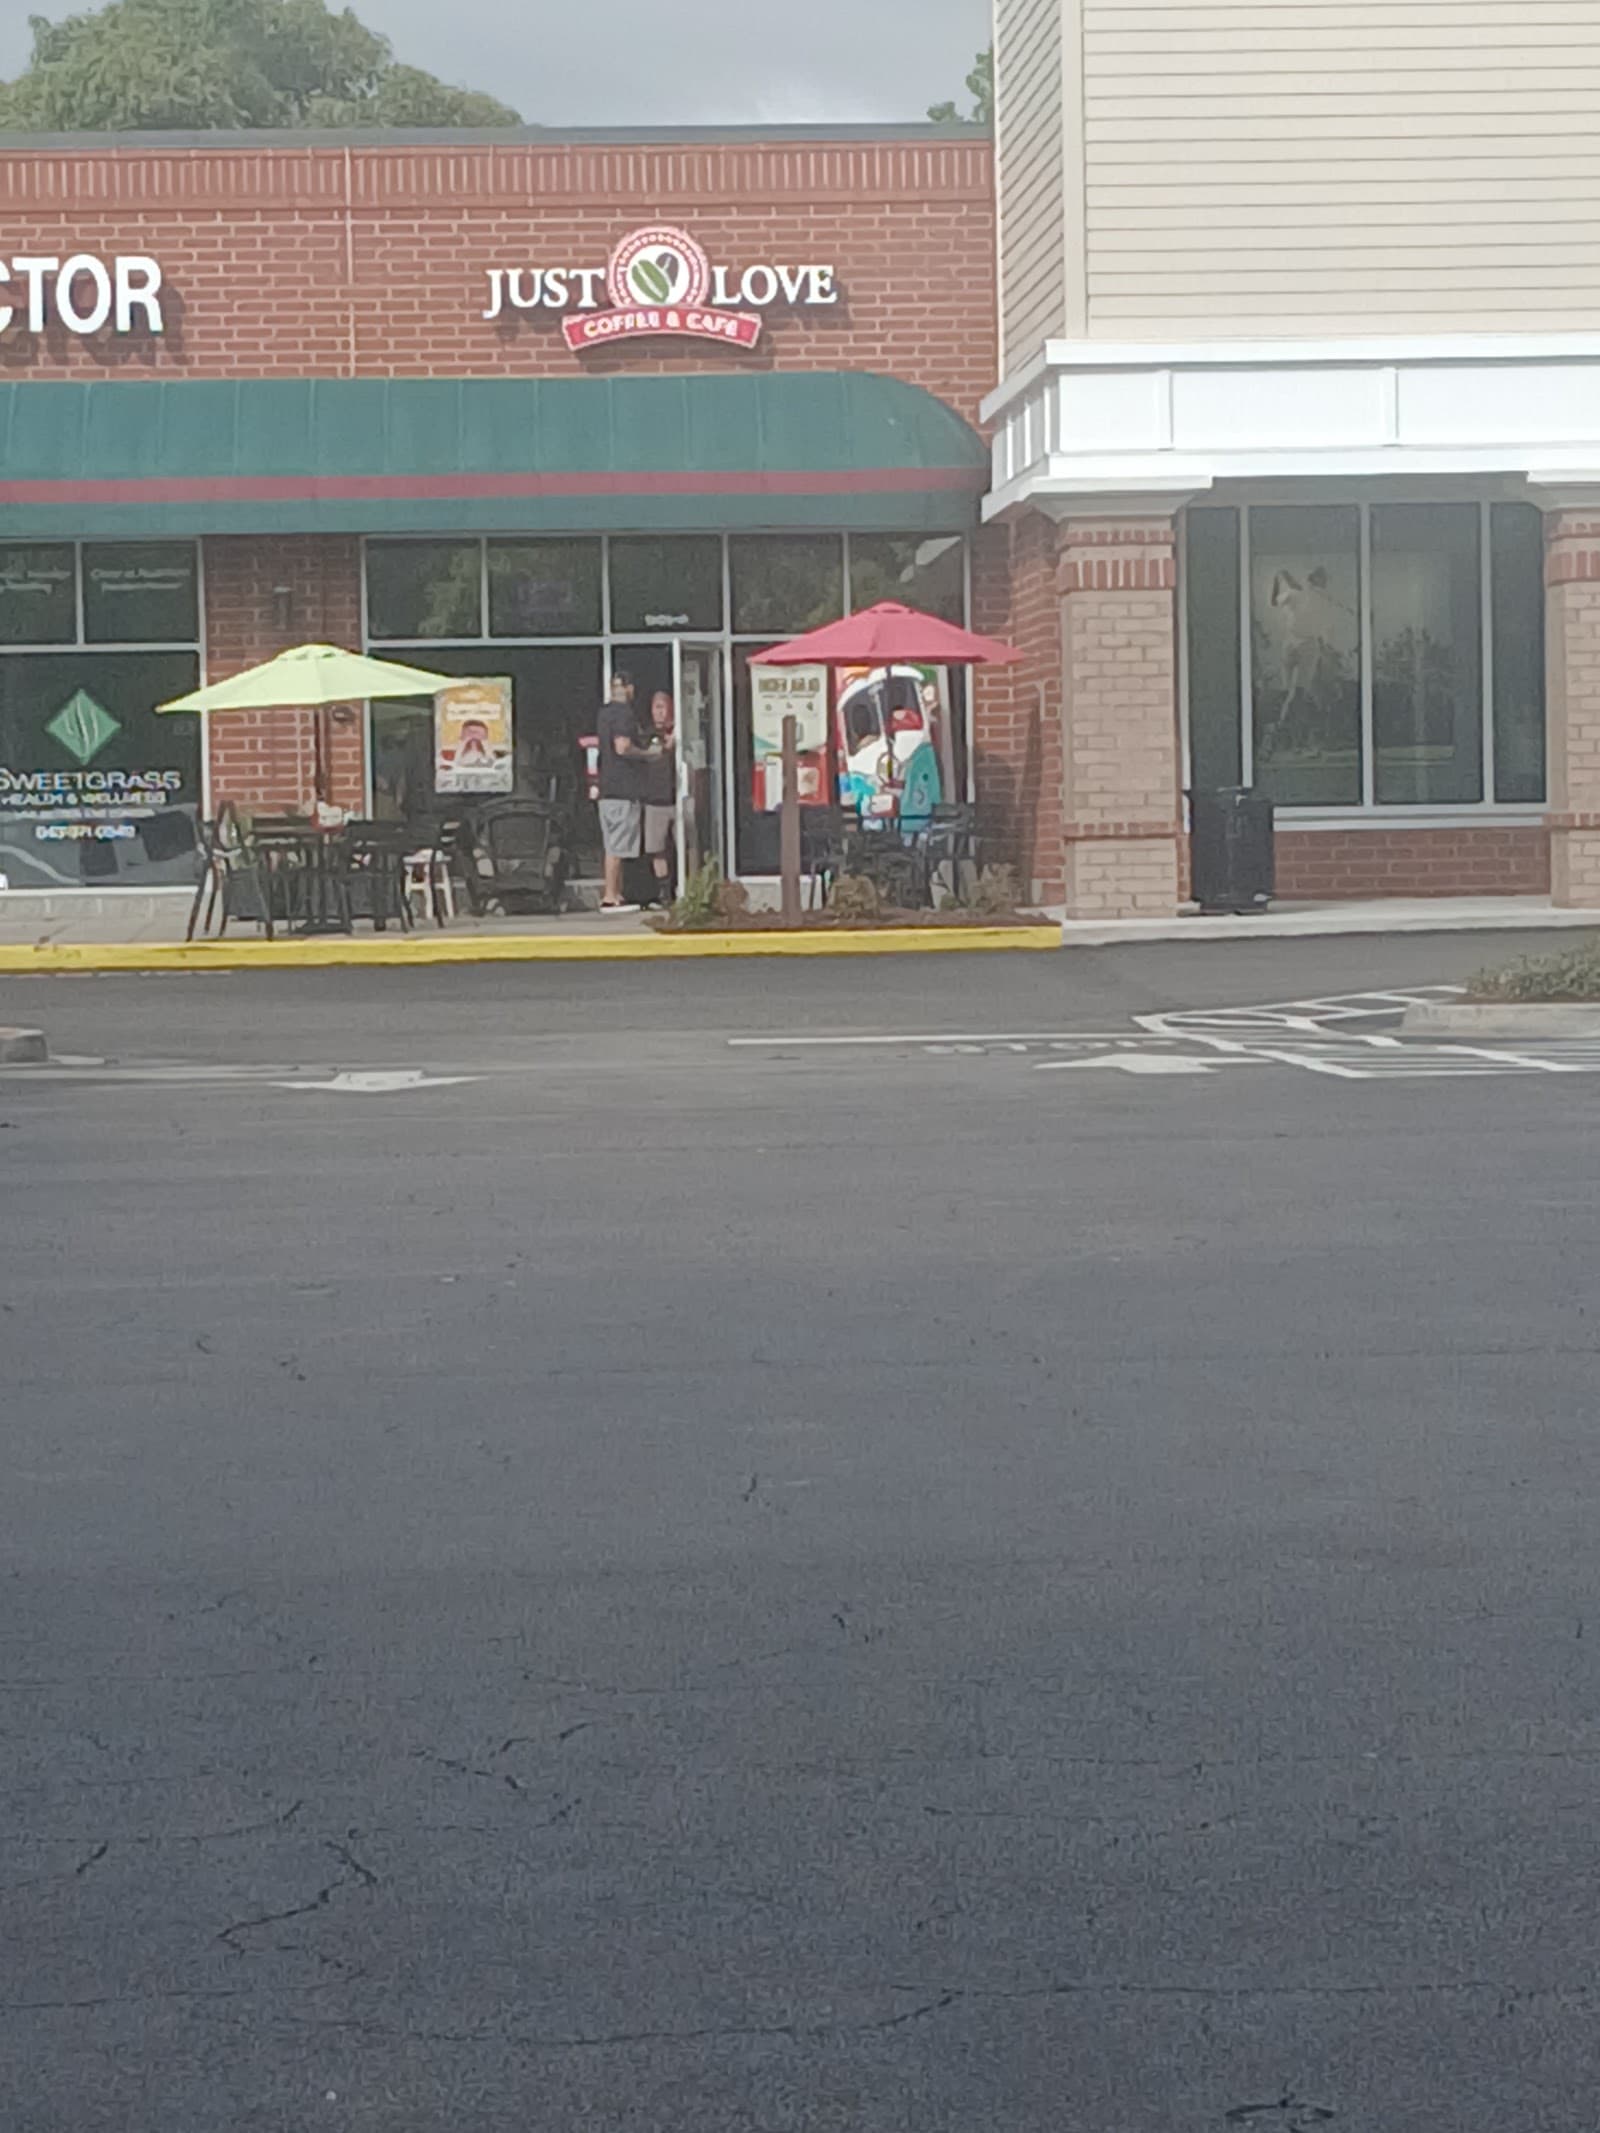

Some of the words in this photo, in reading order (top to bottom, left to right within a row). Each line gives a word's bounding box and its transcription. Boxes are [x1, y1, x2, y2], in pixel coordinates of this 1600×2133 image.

[0, 254, 163, 334] TOR
[483, 267, 606, 319] JUST
[711, 264, 838, 305] LOVE
[583, 311, 661, 338] COFFEE
[665, 311, 681, 328] &
[0, 768, 182, 790] SWEETGRASS
